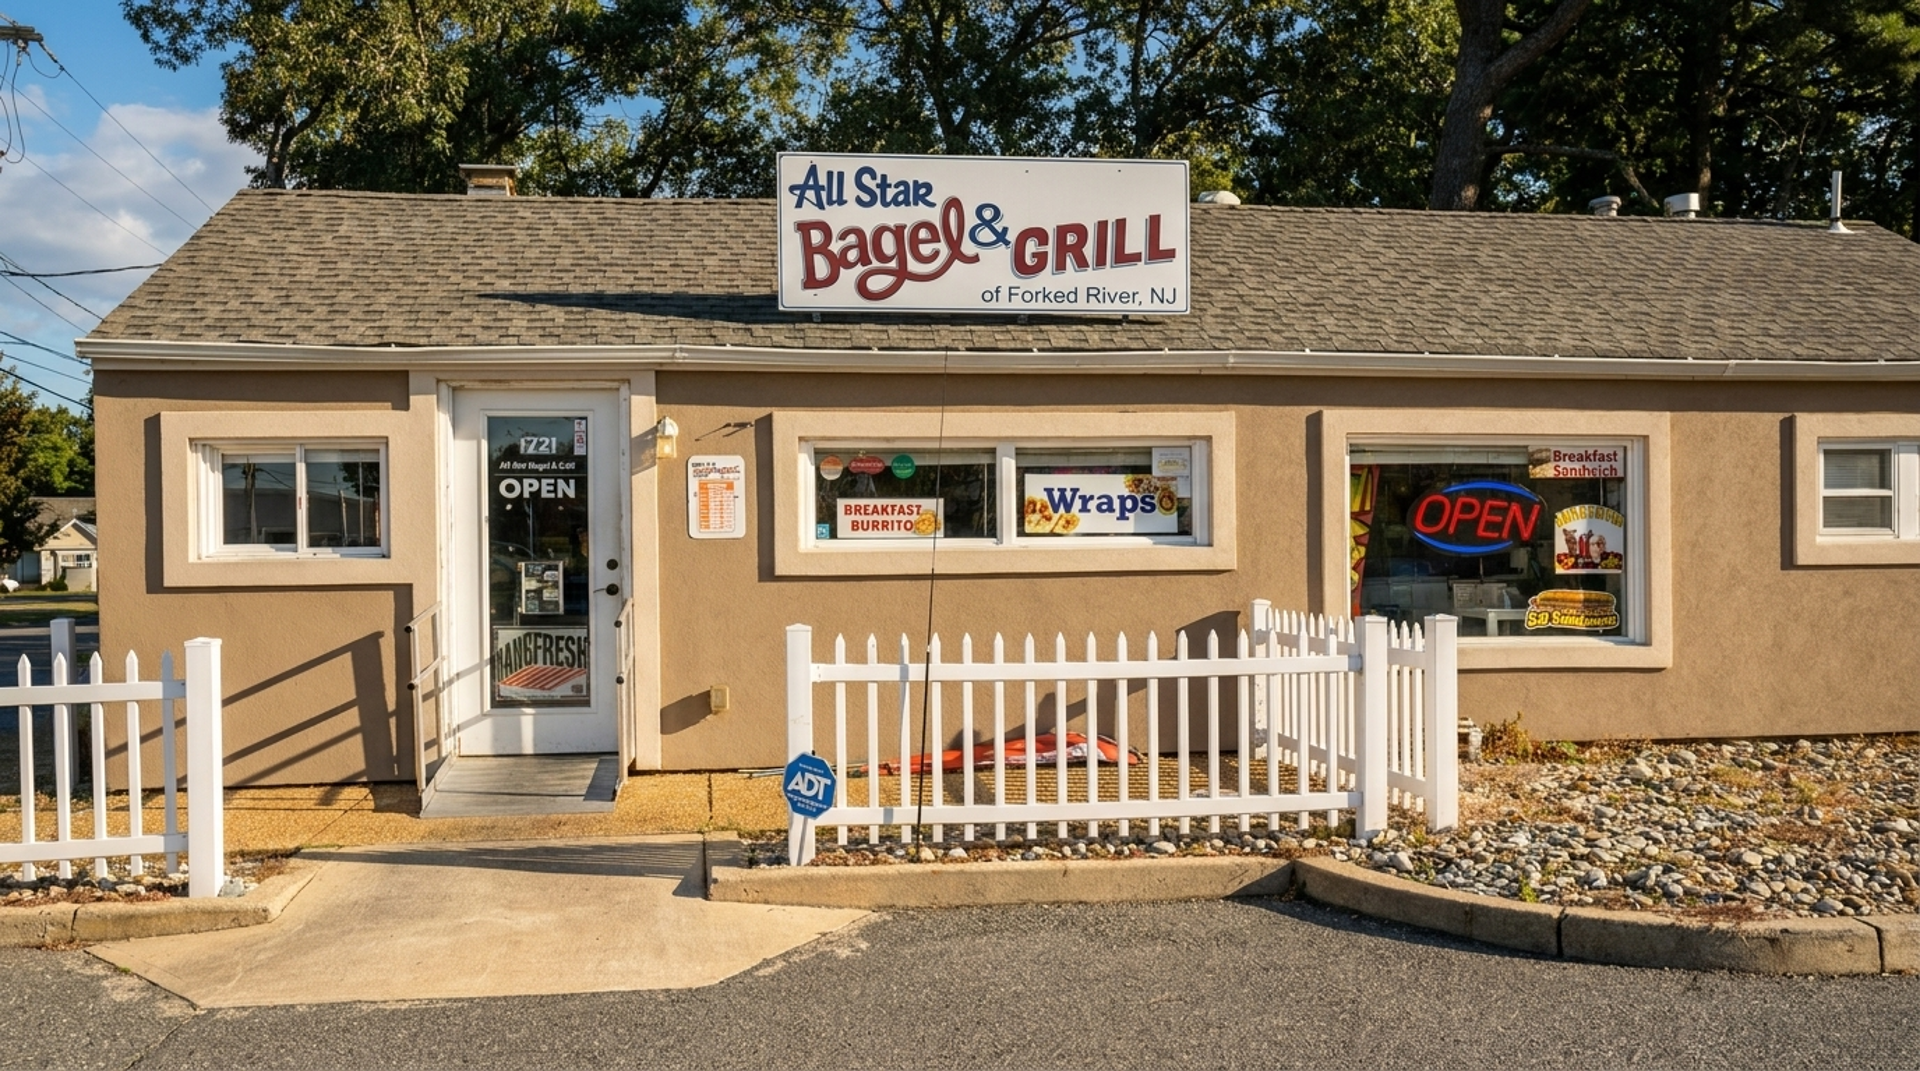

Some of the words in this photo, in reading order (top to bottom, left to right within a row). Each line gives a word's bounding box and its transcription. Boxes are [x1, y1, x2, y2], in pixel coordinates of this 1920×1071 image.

[788, 163, 847, 210] All
[794, 195, 980, 301] Bagel
[968, 203, 1011, 249] &
[1010, 214, 1176, 279] GRILL
[981, 286, 1002, 303] of
[1008, 287, 1078, 304] Forked
[1086, 287, 1142, 306] River,
[1151, 287, 1177, 305] NJ
[520, 436, 557, 454] 1721
[1552, 449, 1618, 462] Breakfast
[499, 478, 576, 499] OPEN
[843, 504, 922, 516] BREAKFAST
[1043, 487, 1158, 520] Wraps
[850, 520, 914, 532] BURRITO
[1413, 494, 1541, 541] OPEN
[787, 771, 830, 800] ADT
